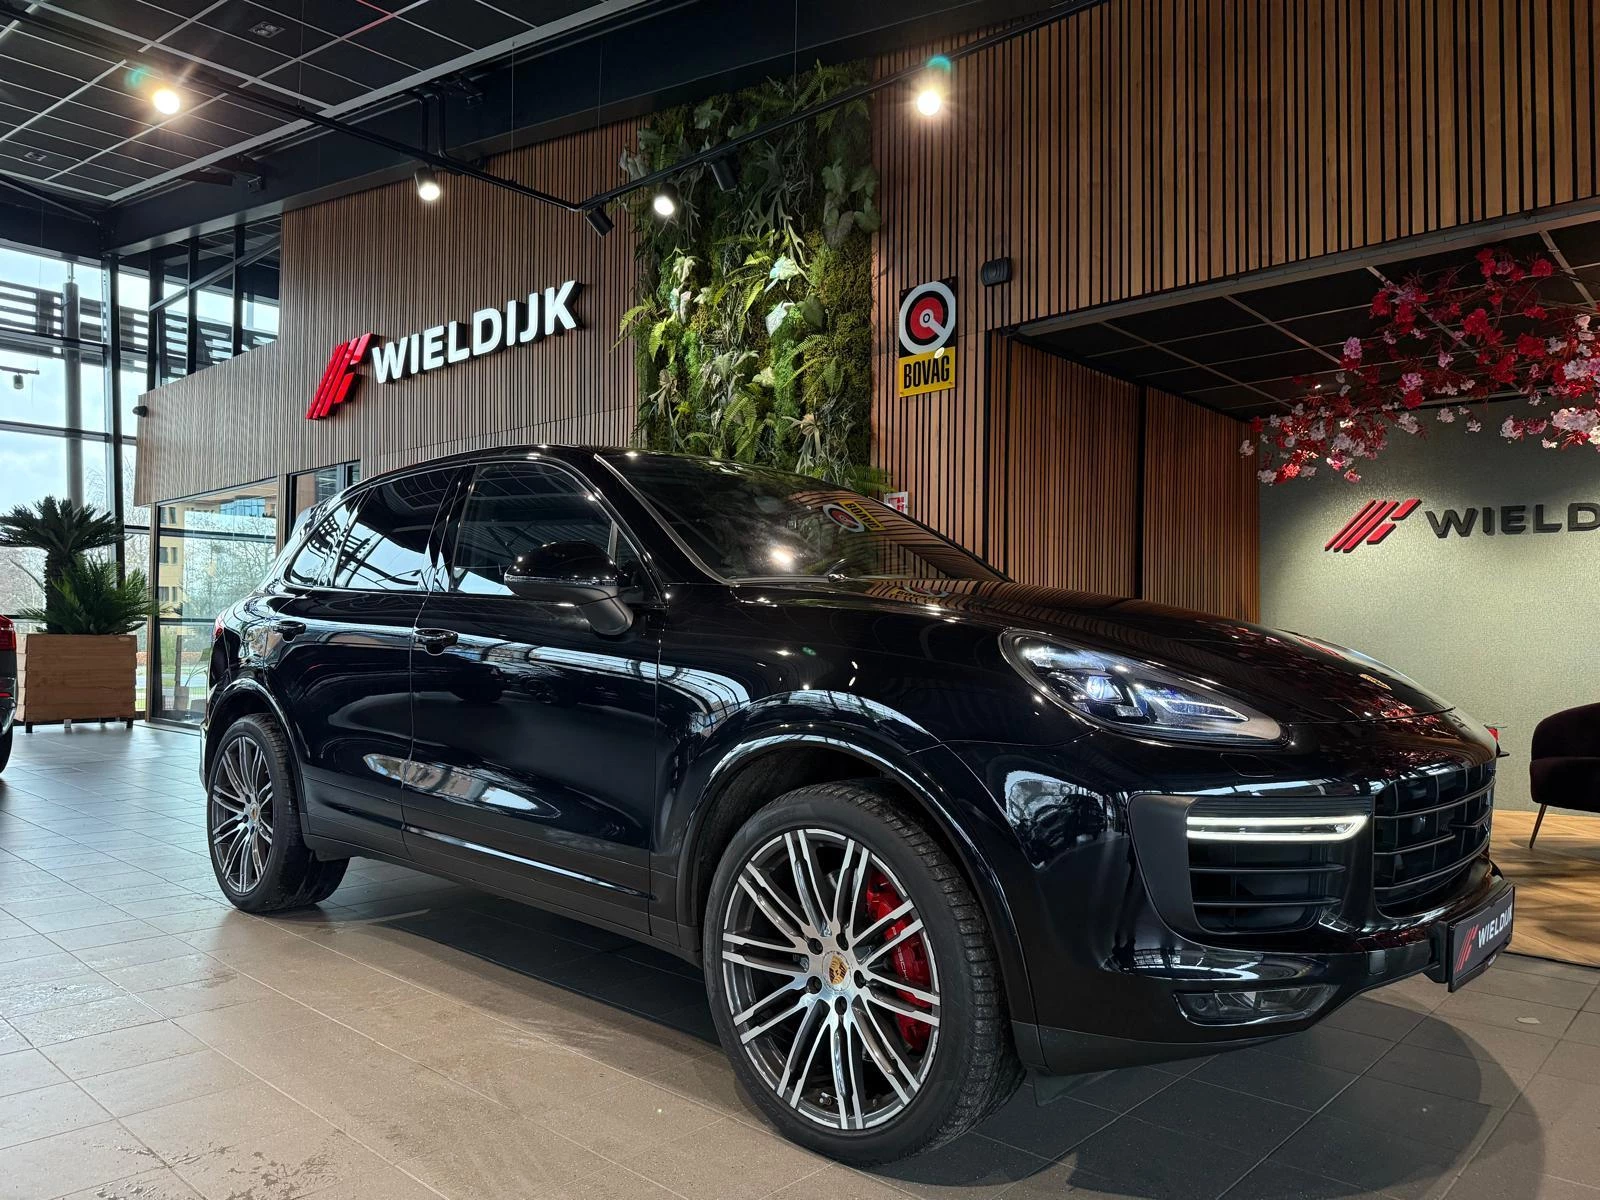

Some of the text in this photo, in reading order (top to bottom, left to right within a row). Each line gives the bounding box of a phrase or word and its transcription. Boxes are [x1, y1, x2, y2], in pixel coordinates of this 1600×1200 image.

[371, 280, 578, 384] WIELDIJK
[903, 355, 950, 389] BOVAG
[1425, 502, 1600, 538] WIELD
